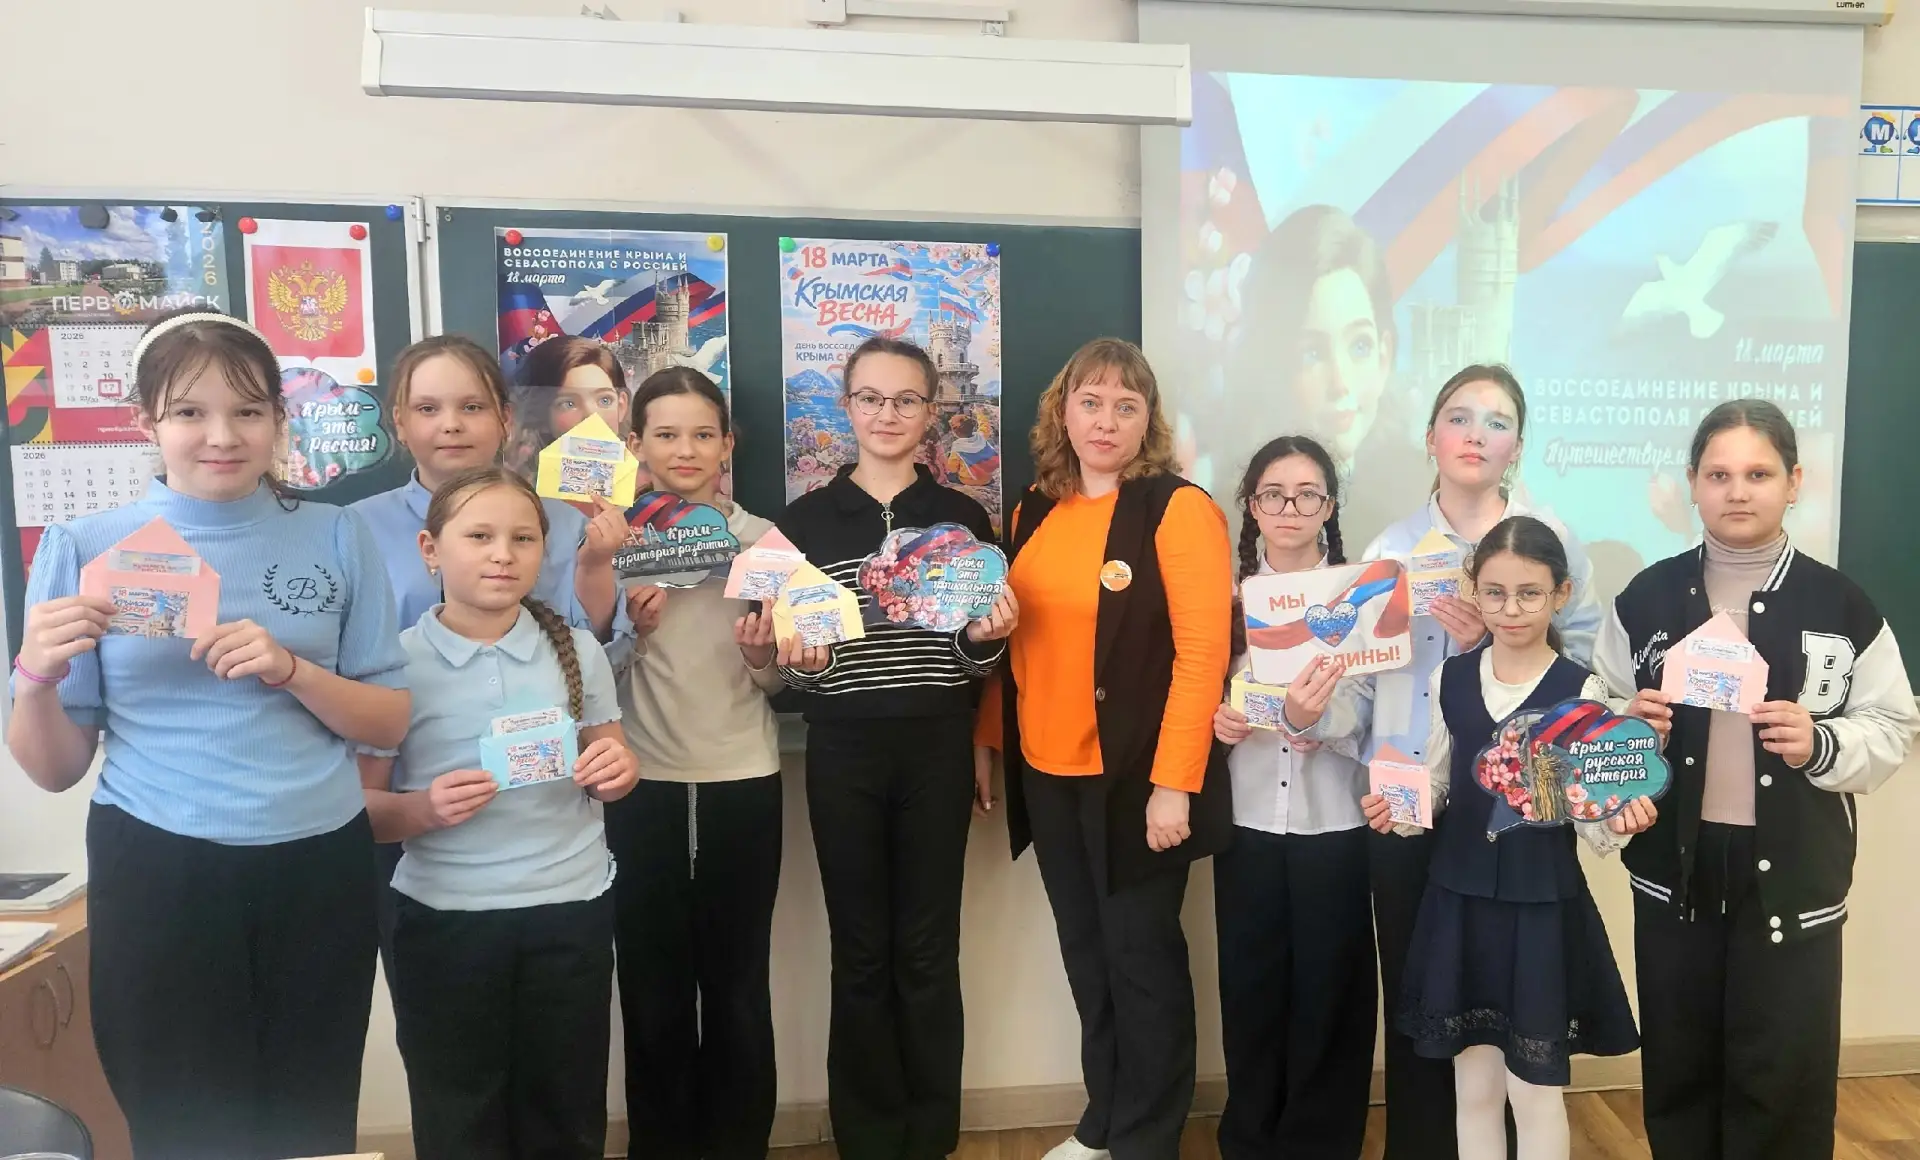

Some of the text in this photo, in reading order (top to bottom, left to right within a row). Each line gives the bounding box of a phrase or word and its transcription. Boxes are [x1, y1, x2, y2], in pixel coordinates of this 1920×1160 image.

[1871, 123, 1890, 140] М
[503, 248, 687, 261] ВОССОЕДИНЕНИЕ КРЫМА И
[801, 246, 889, 268] 18 МАРТА
[504, 259, 688, 271] СЕВАСТОПОЛЯ С РОССИЕЙ
[816, 299, 899, 327] ВЕСНА
[60, 332, 85, 340] 2026
[795, 342, 817, 350] ДЕНЬ
[796, 351, 834, 361] КРЫМА
[1534, 378, 1823, 401] ВОССОЕДИНЕНИЕ КРЫМА И
[1533, 406, 1690, 427] СЕВАСТОПОЛЯ
[322, 420, 358, 434] это
[308, 434, 377, 454] Россия!
[22, 452, 46, 460] 2026
[108, 467, 115, 475] 2
[129, 478, 140, 486] 10
[64, 491, 75, 499] 14
[86, 490, 97, 498] 15
[129, 489, 140, 497] 17
[42, 503, 54, 511] 20
[86, 502, 98, 510] 22
[43, 514, 55, 522] 27
[611, 539, 731, 569] ерритория развития
[958, 571, 979, 581] это
[286, 577, 318, 600] B
[1269, 593, 1306, 612] МЫ
[1319, 645, 1401, 671] ЕДИНЫ!
[1797, 630, 1857, 716] B
[1568, 740, 1614, 759] Крым
[1627, 737, 1655, 750] это
[1583, 753, 1644, 774] русская
[1585, 768, 1647, 786] история
